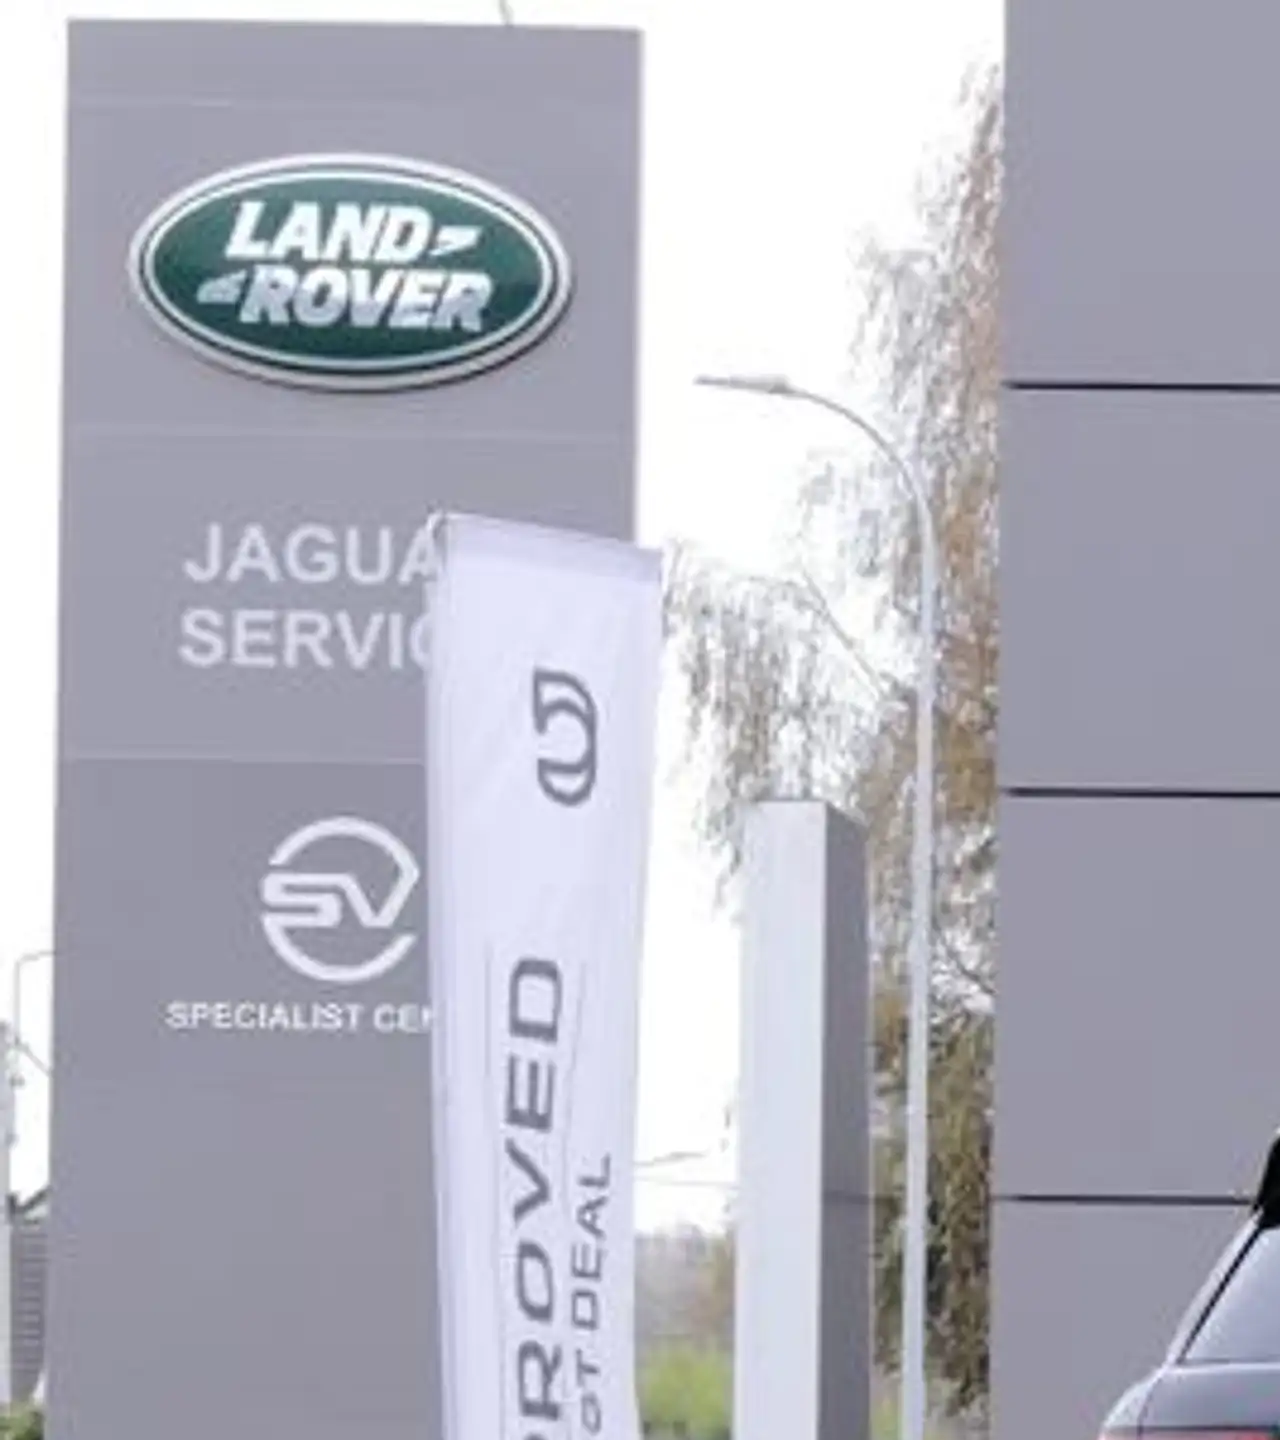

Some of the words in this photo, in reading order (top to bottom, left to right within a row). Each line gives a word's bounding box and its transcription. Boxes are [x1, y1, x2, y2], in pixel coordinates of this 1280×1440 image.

[225, 200, 430, 260] LAND
[239, 265, 494, 332] ROVER
[182, 523, 437, 584] JAGUA
[165, 1002, 362, 1031] SPECIALIST
[572, 1153, 612, 1330] DEAL
